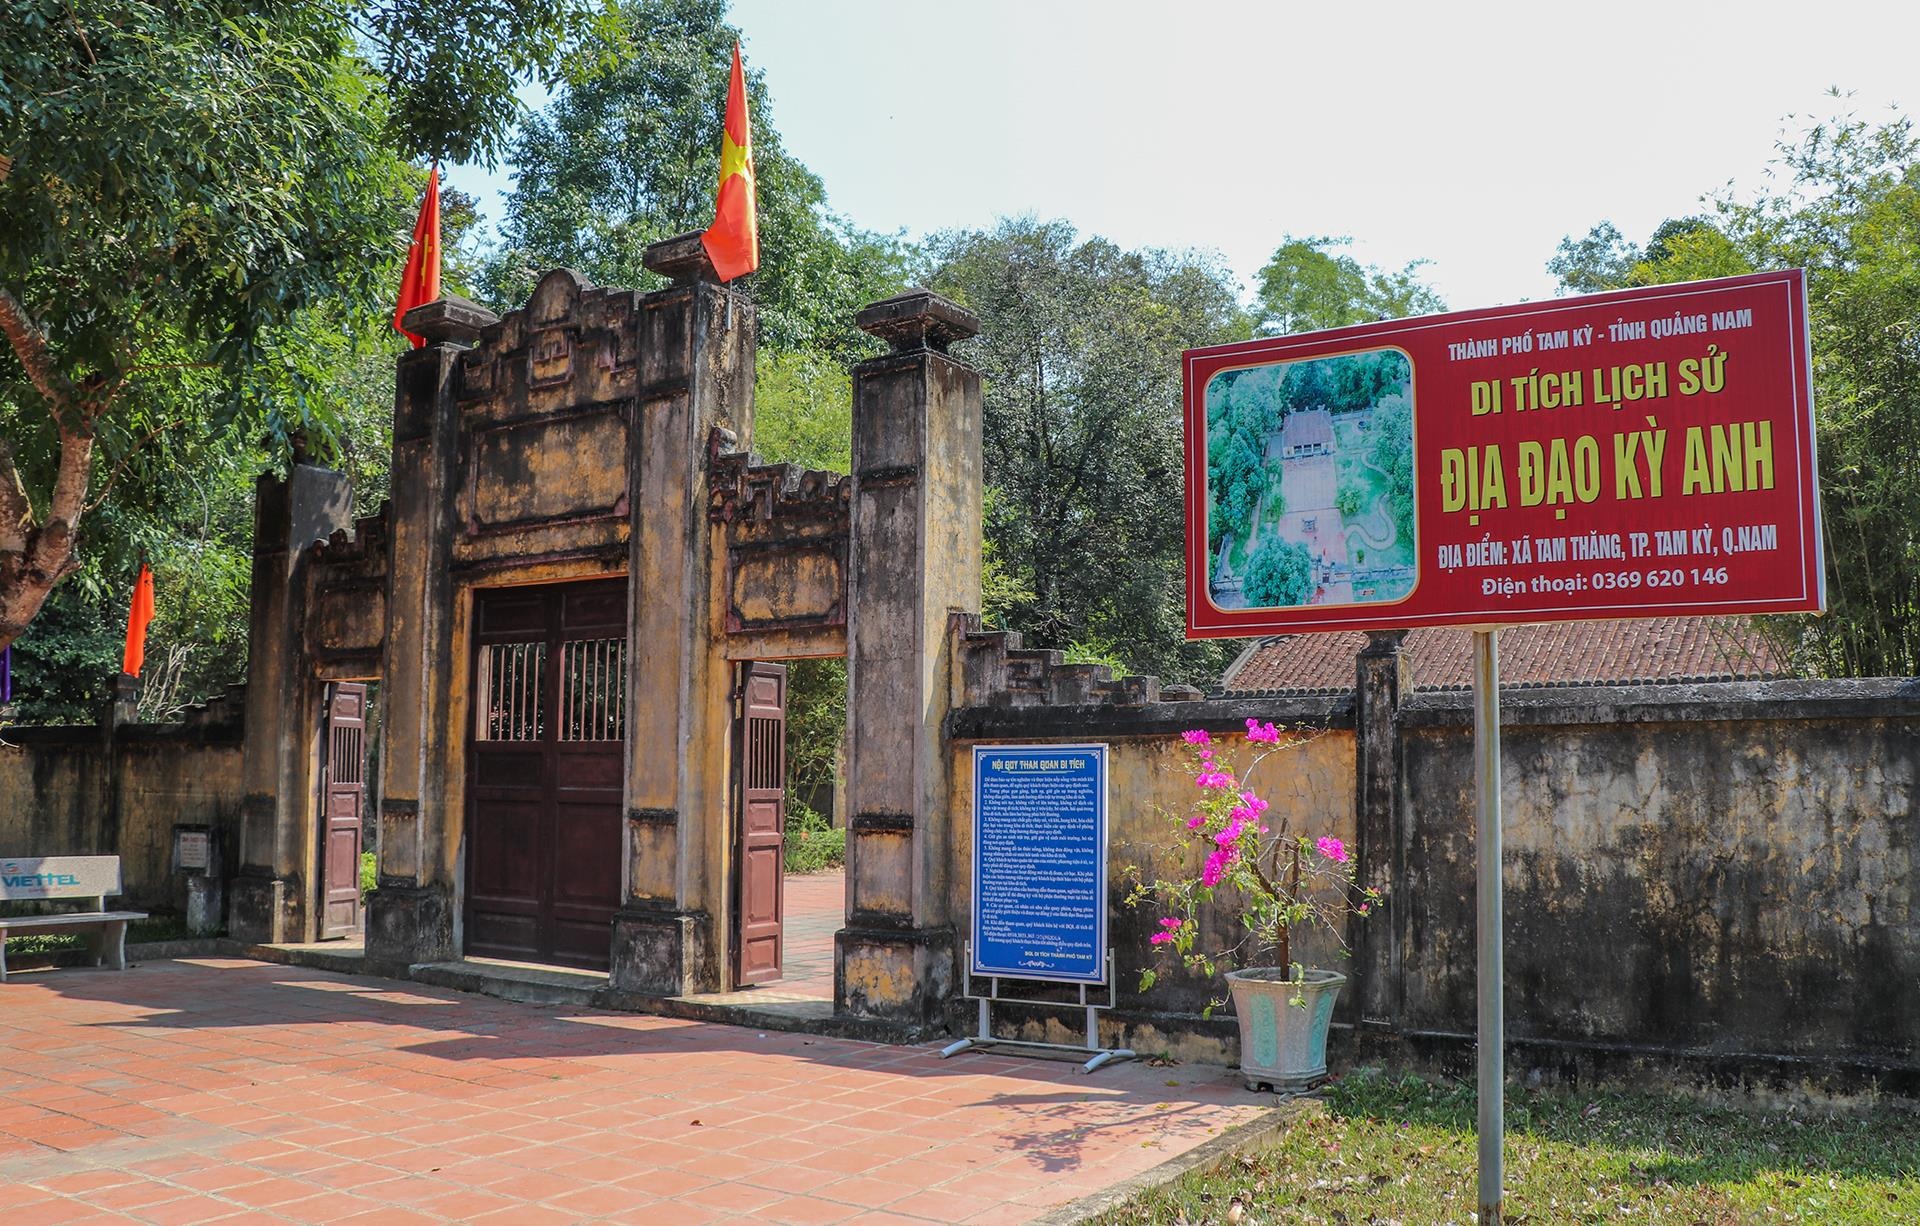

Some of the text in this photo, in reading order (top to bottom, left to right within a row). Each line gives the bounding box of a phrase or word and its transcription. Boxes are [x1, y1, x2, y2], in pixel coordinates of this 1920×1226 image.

[1448, 337, 1498, 361] THÀNH
[1502, 328, 1534, 355] PHỐ
[1536, 331, 1569, 351] TAM
[1573, 326, 1594, 348] KỲ
[1609, 318, 1646, 343] TỈNH
[1651, 311, 1707, 339] QUẢNG
[1712, 309, 1753, 331] NAM
[1471, 344, 1729, 416] DI TÍCH LỊCH SỬ
[1440, 416, 1776, 527] ĐỊA ĐẠO KỲ ANH
[1438, 523, 1777, 574] ĐỊA ĐIỂM: XÃ TAM THĂNG, TP. TAM KỲ, Q.NAM
[1482, 567, 1729, 599] Điện thoại: 0369 620 146
[1005, 760, 1018, 771] QUY
[1019, 760, 1039, 769] THAM
[1040, 760, 1059, 771] QUAN
